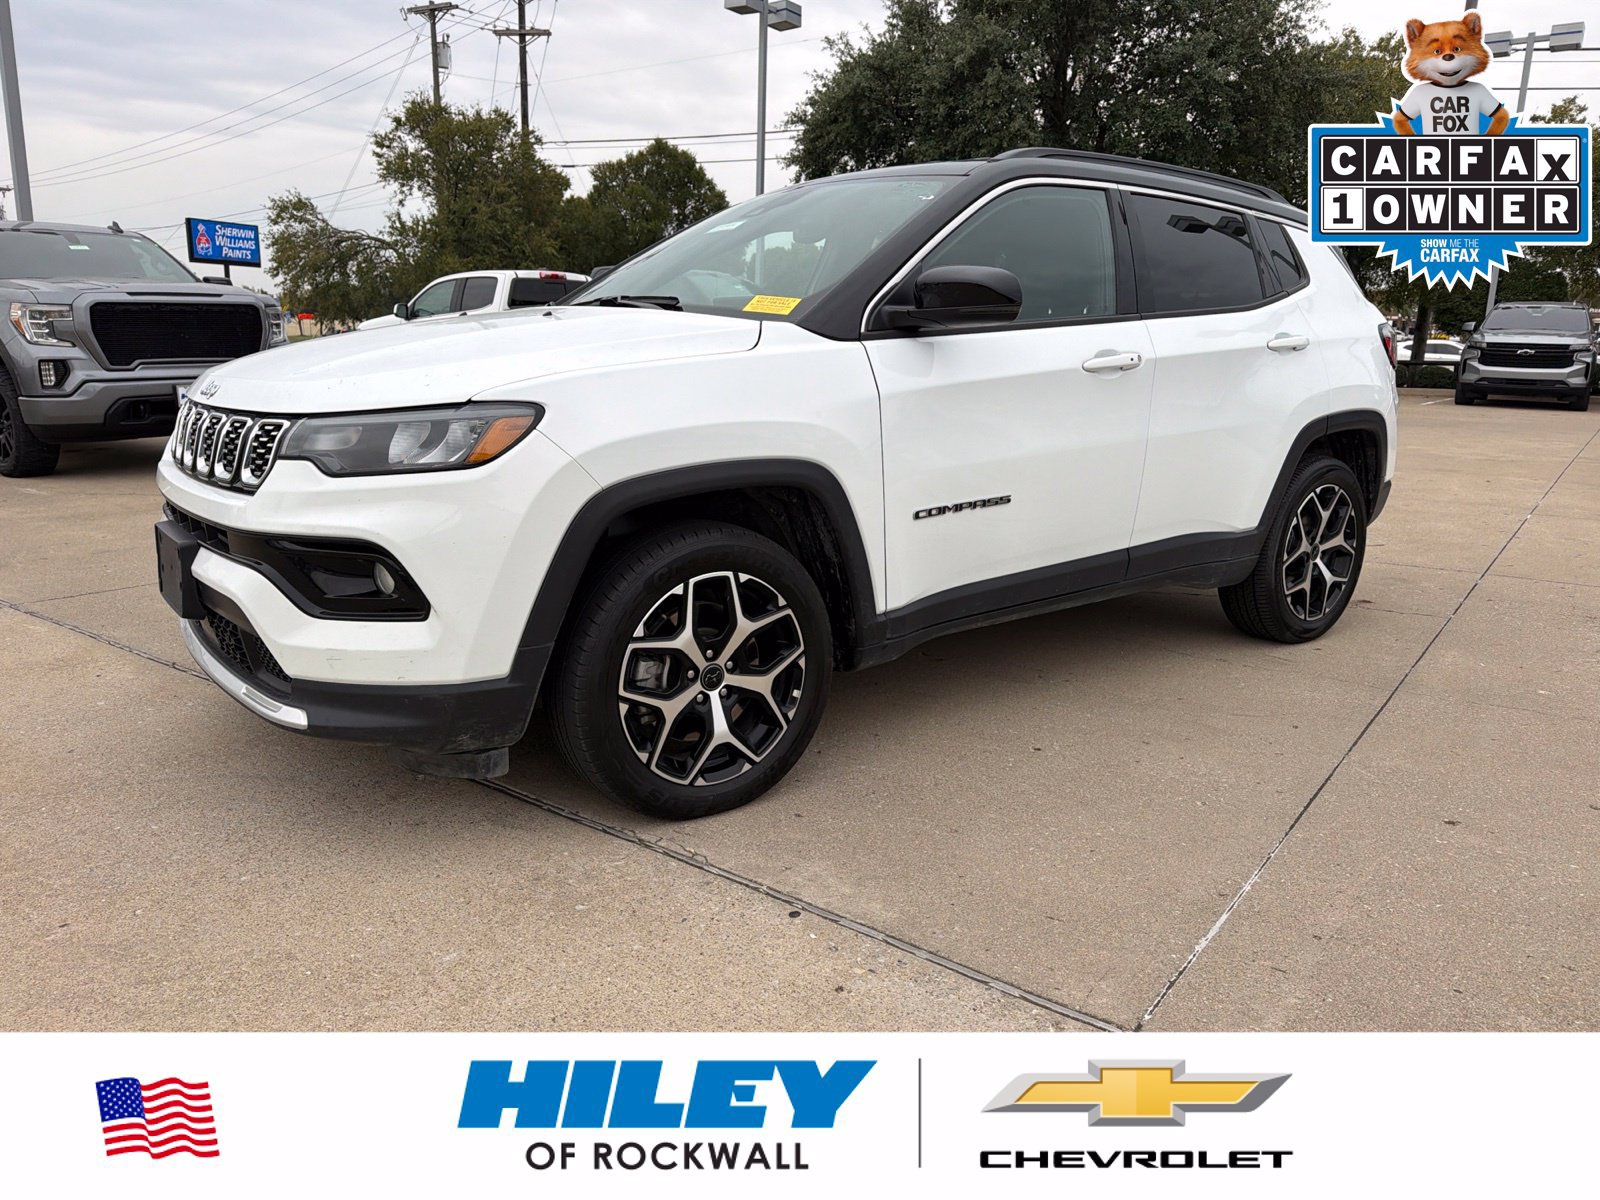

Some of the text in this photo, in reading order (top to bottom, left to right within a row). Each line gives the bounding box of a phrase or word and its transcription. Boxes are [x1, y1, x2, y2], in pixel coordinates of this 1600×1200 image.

[215, 225, 255, 239] SHERWIN
[215, 235, 256, 250] WILLIAMS
[222, 246, 252, 259] PAINTS
[913, 494, 1011, 520] COMPASS
